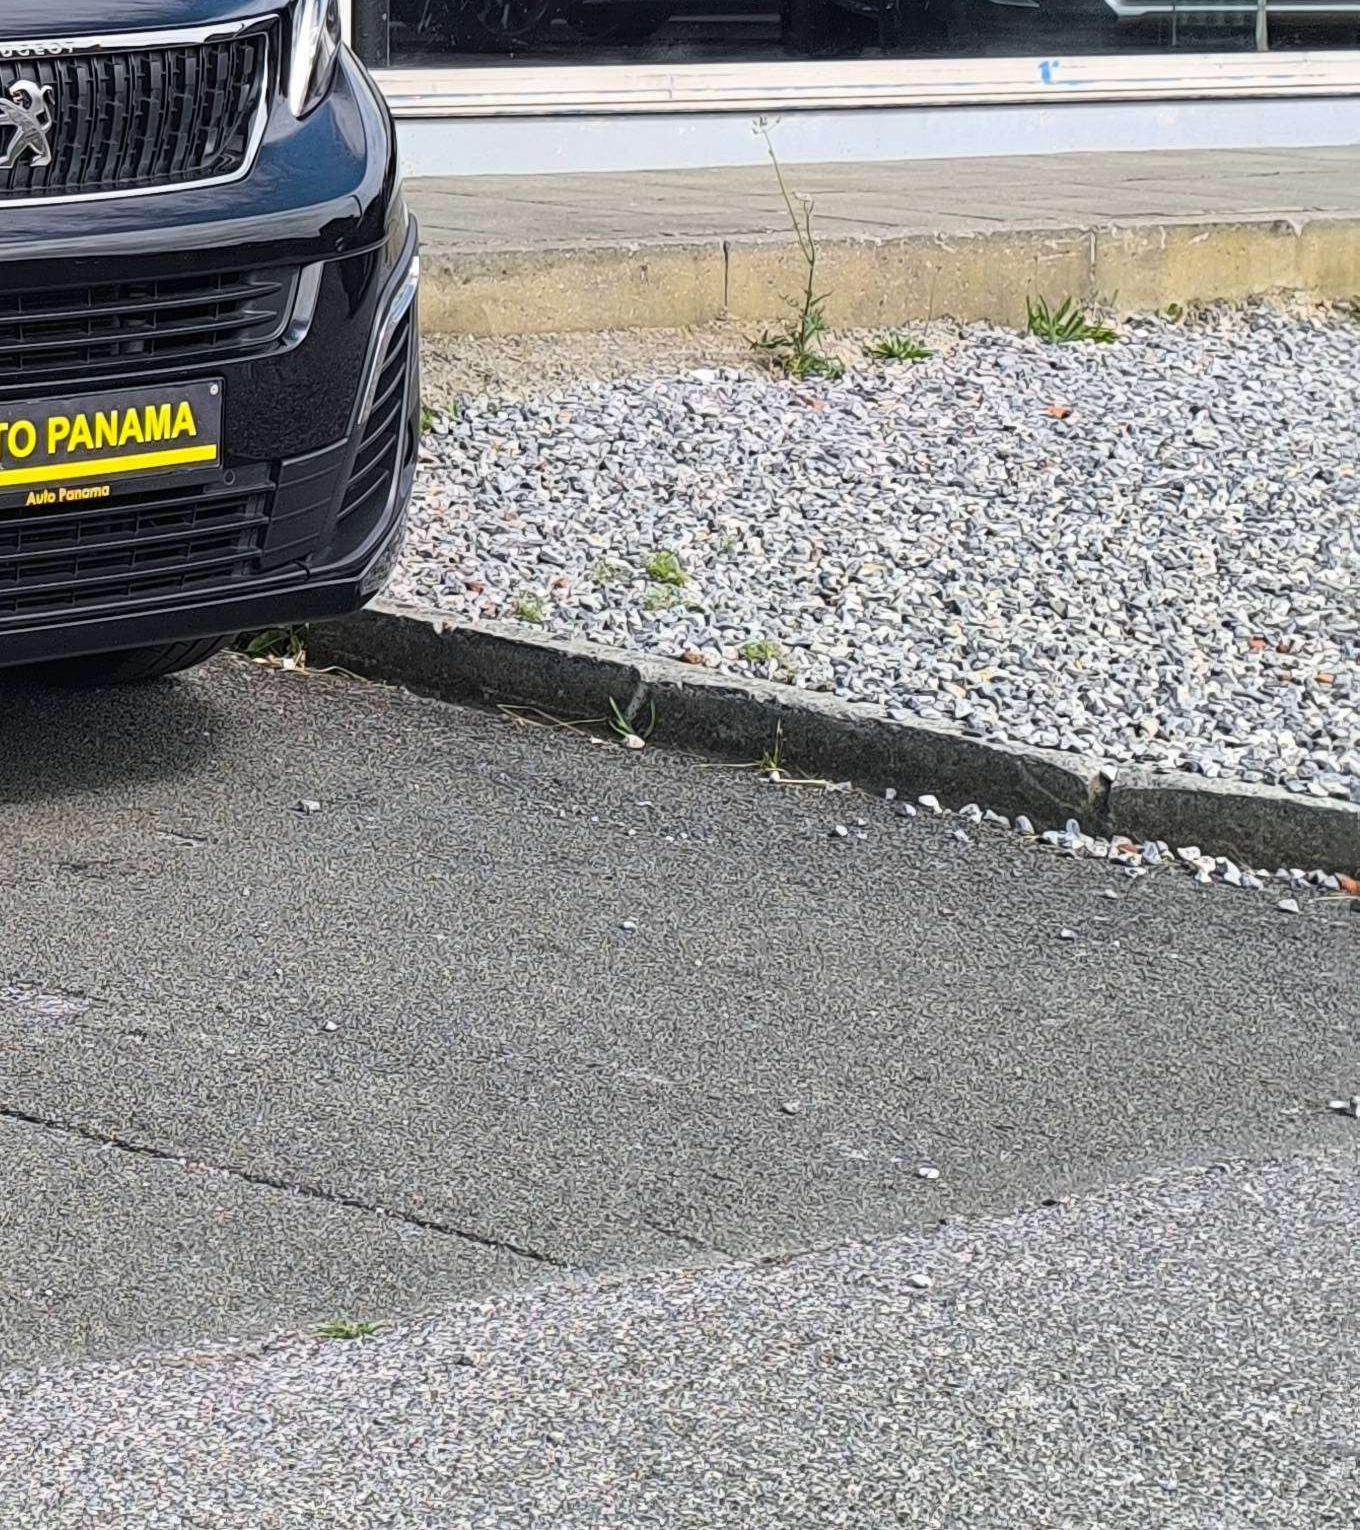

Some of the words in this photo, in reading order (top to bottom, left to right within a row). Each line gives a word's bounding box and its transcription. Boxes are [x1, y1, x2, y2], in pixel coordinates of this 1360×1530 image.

[47, 401, 197, 454] PANAMA
[25, 490, 56, 507] Auto
[58, 485, 111, 503] Panama
